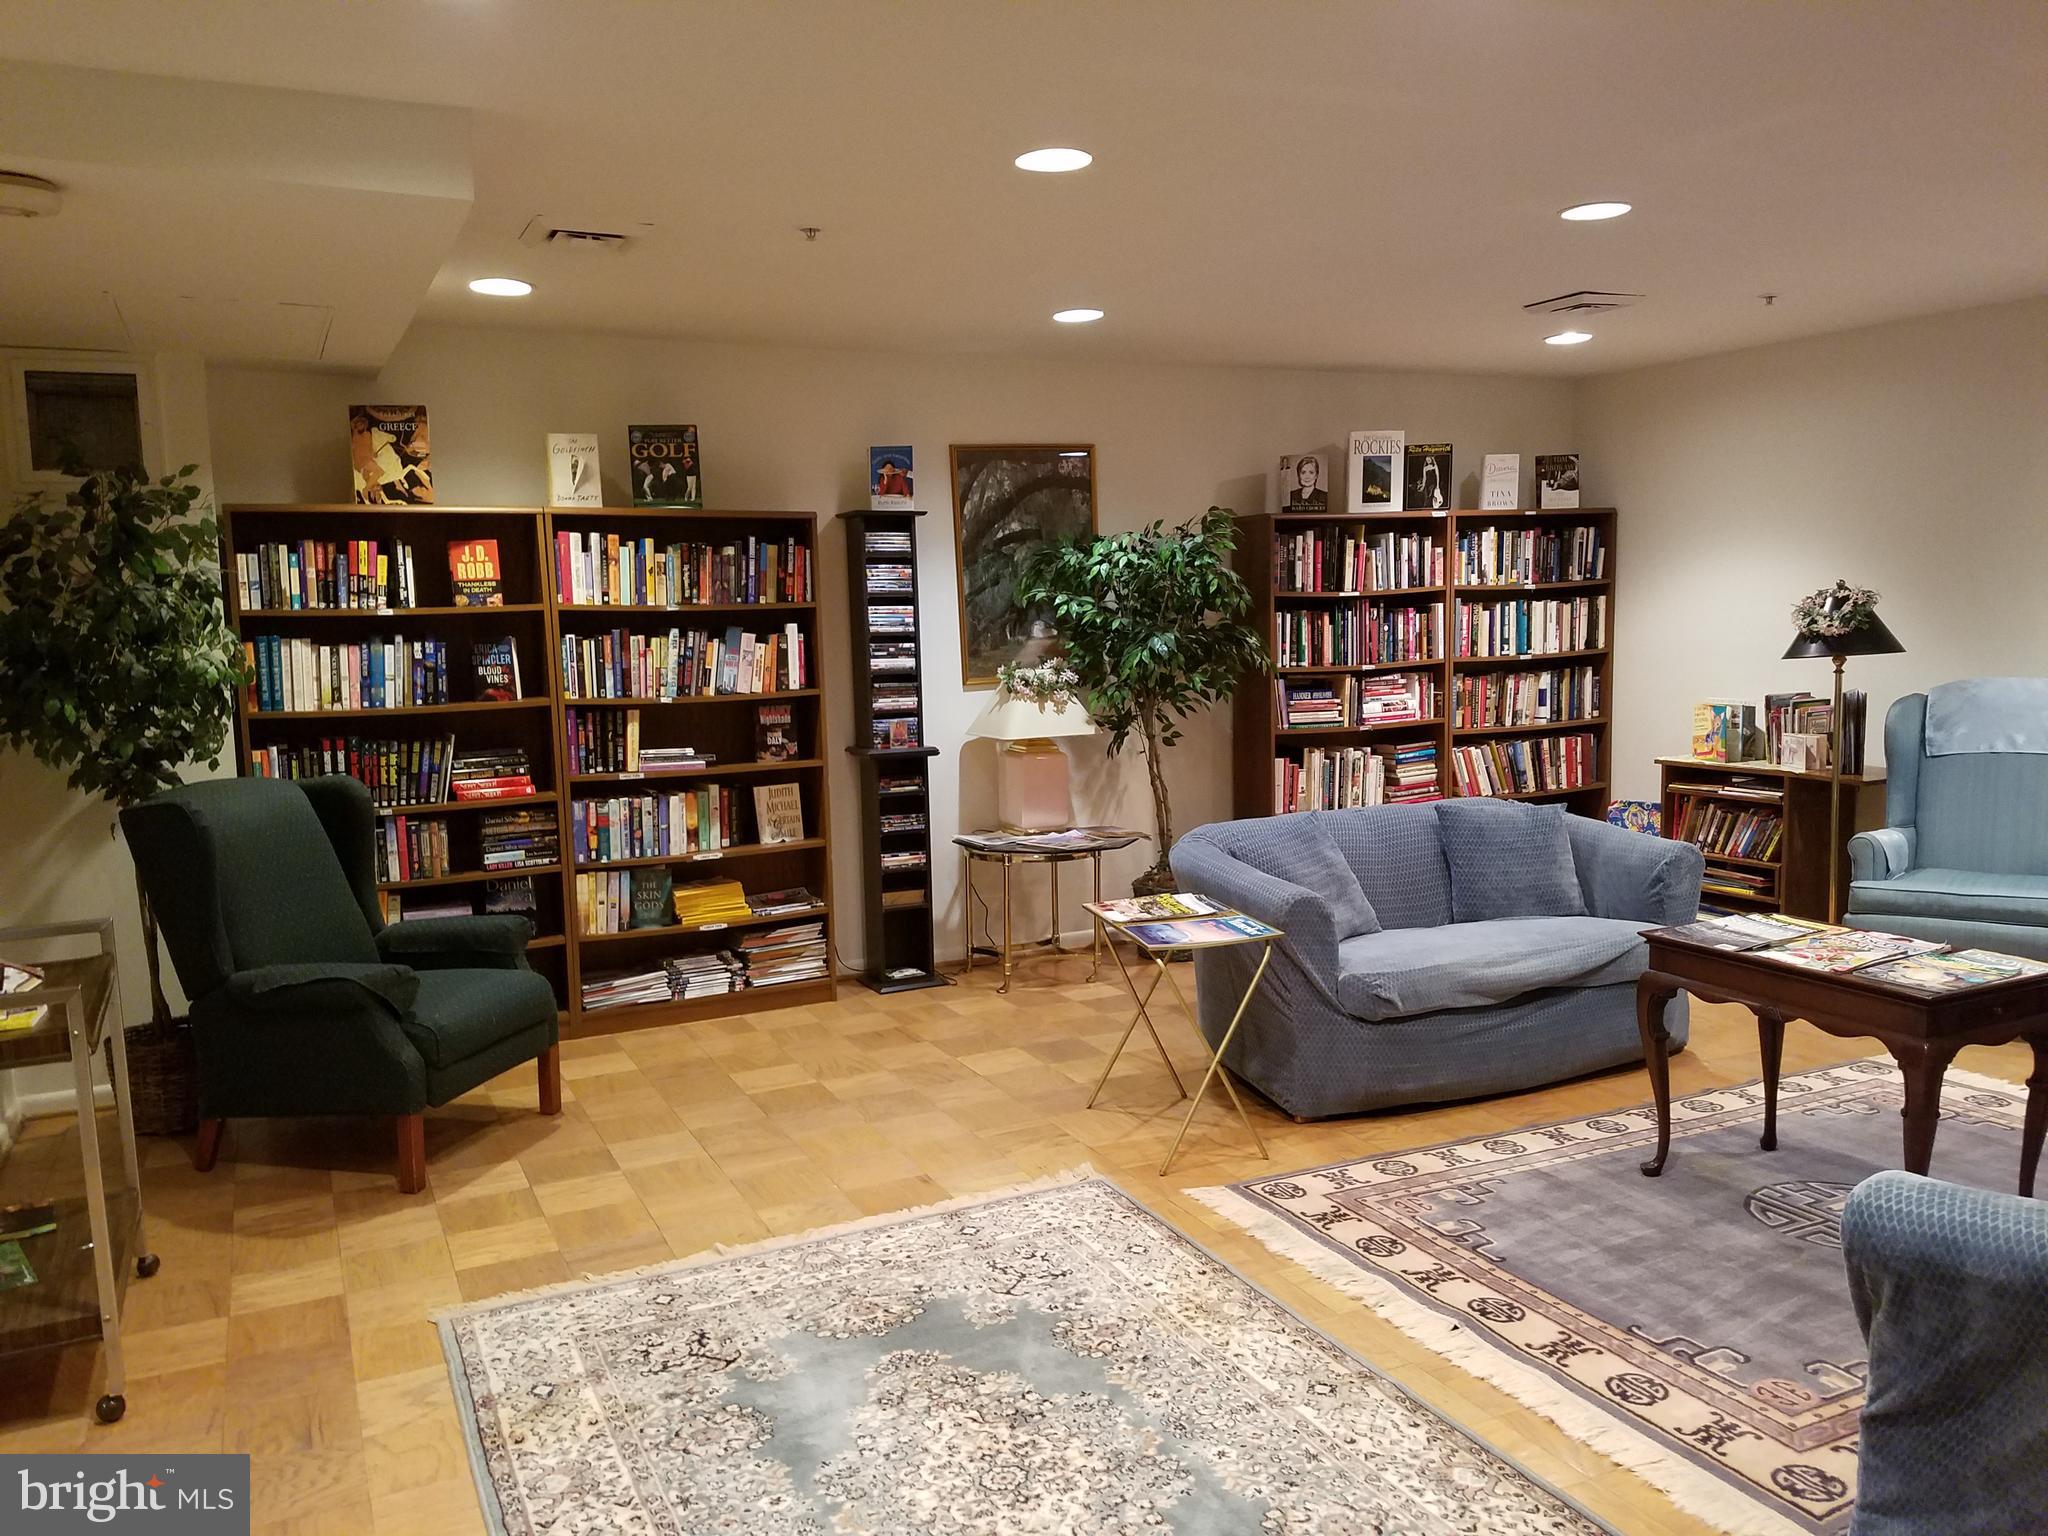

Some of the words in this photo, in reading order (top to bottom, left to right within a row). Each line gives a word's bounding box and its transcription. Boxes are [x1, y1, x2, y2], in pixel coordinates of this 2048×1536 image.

[379, 422, 417, 431] GREECE
[631, 442, 696, 458] GOLF
[1353, 439, 1401, 455] ROCKIES
[461, 545, 474, 562] J.
[475, 544, 489, 562] D.
[457, 562, 494, 580] ROBB
[471, 653, 512, 665] SPINDLER
[478, 665, 502, 676] BLOOD
[486, 674, 509, 684] VINES
[768, 786, 794, 800] JUDITH
[766, 800, 800, 815] MICHAEL
[636, 890, 662, 900] SKIN
[634, 900, 664, 910] GODS
